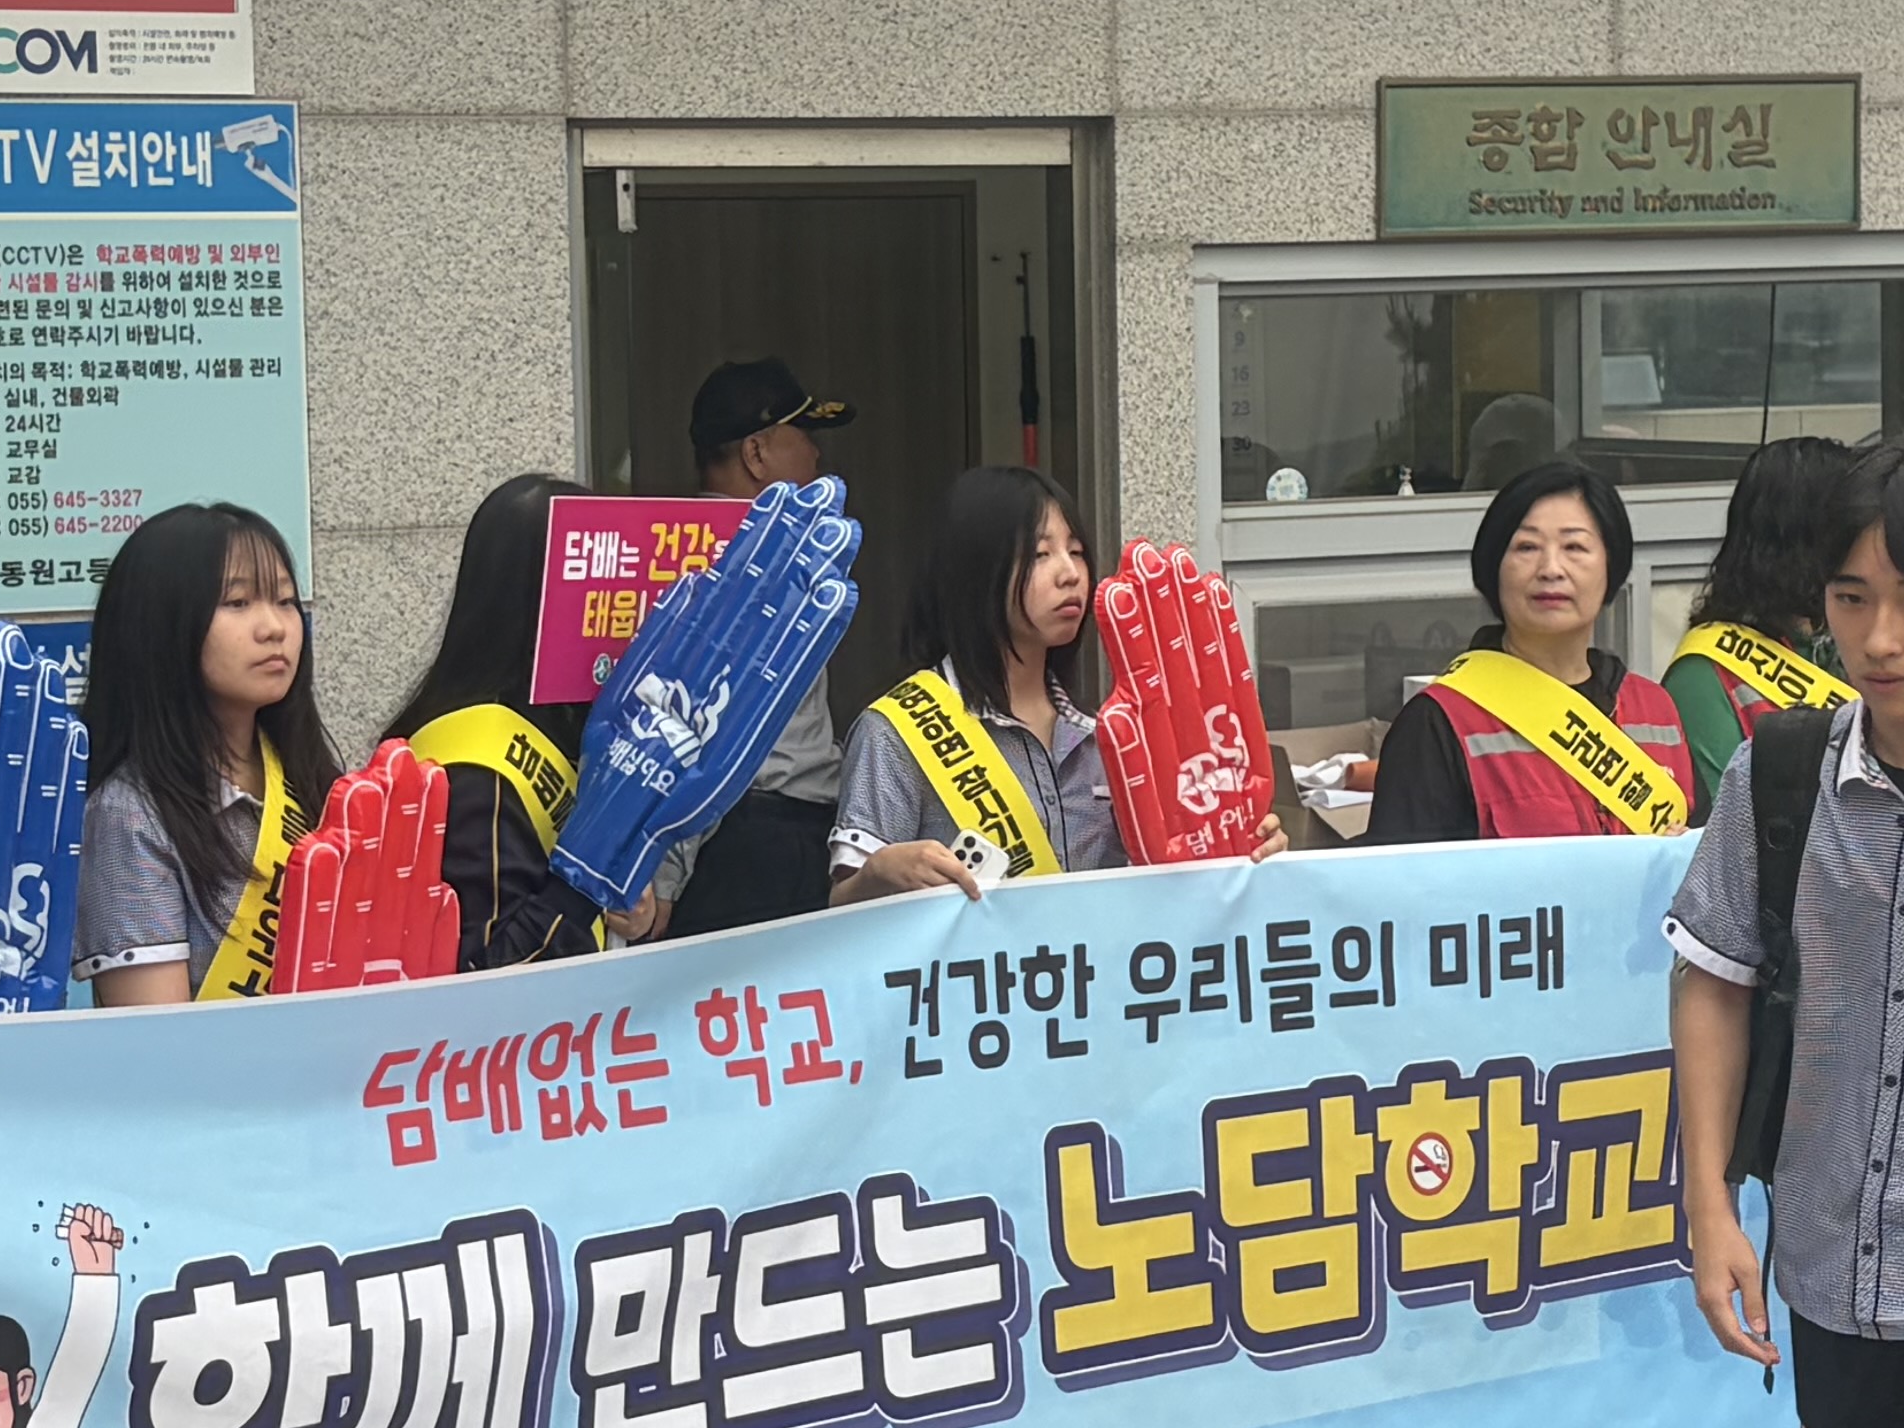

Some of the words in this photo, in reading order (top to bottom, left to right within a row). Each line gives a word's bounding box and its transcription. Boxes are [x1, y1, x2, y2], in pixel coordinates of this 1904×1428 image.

[1466, 102, 1585, 173] 종합
[1605, 103, 1777, 171] 안내실
[65, 130, 213, 188] 설치안내
[1468, 188, 1574, 220] Security
[1580, 187, 1625, 214] and
[1633, 184, 1777, 212] Information
[208, 244, 223, 265] 및
[230, 243, 281, 264] 외부인
[66, 272, 114, 294] 감시를
[122, 271, 172, 293] 위하여
[177, 270, 228, 292] 설치한
[234, 270, 283, 292] 것으로
[36, 299, 71, 320] 문의
[77, 298, 93, 320] 및
[100, 297, 187, 320] 신고사항이
[194, 296, 243, 319] 있으신
[250, 296, 284, 318] 분은
[31, 324, 120, 347] 연락주시기
[126, 323, 202, 346] 바랍니다.
[32, 361, 73, 382] 목적:
[250, 357, 282, 377] 관리
[4, 387, 46, 409] 실내,
[5, 413, 62, 433] 24시간
[6, 440, 58, 459] 교무실
[7, 465, 41, 485] 교감
[7, 490, 48, 511] 055)
[53, 489, 143, 509] 645-3327
[8, 516, 49, 537] 055)
[54, 514, 144, 535] 645-2200
[562, 531, 639, 581] 담배는
[0, 558, 112, 587] 동원고등
[1715, 629, 1814, 700] 당신이
[1549, 709, 1629, 788] 너라면
[362, 1007, 668, 1166] 담배없는
[694, 987, 864, 1108] 학교,
[885, 944, 1095, 1080] 건강한
[1124, 918, 1397, 1044] 우리들의
[1429, 905, 1566, 997] 미래
[1050, 1065, 1678, 1356] 노담학교
